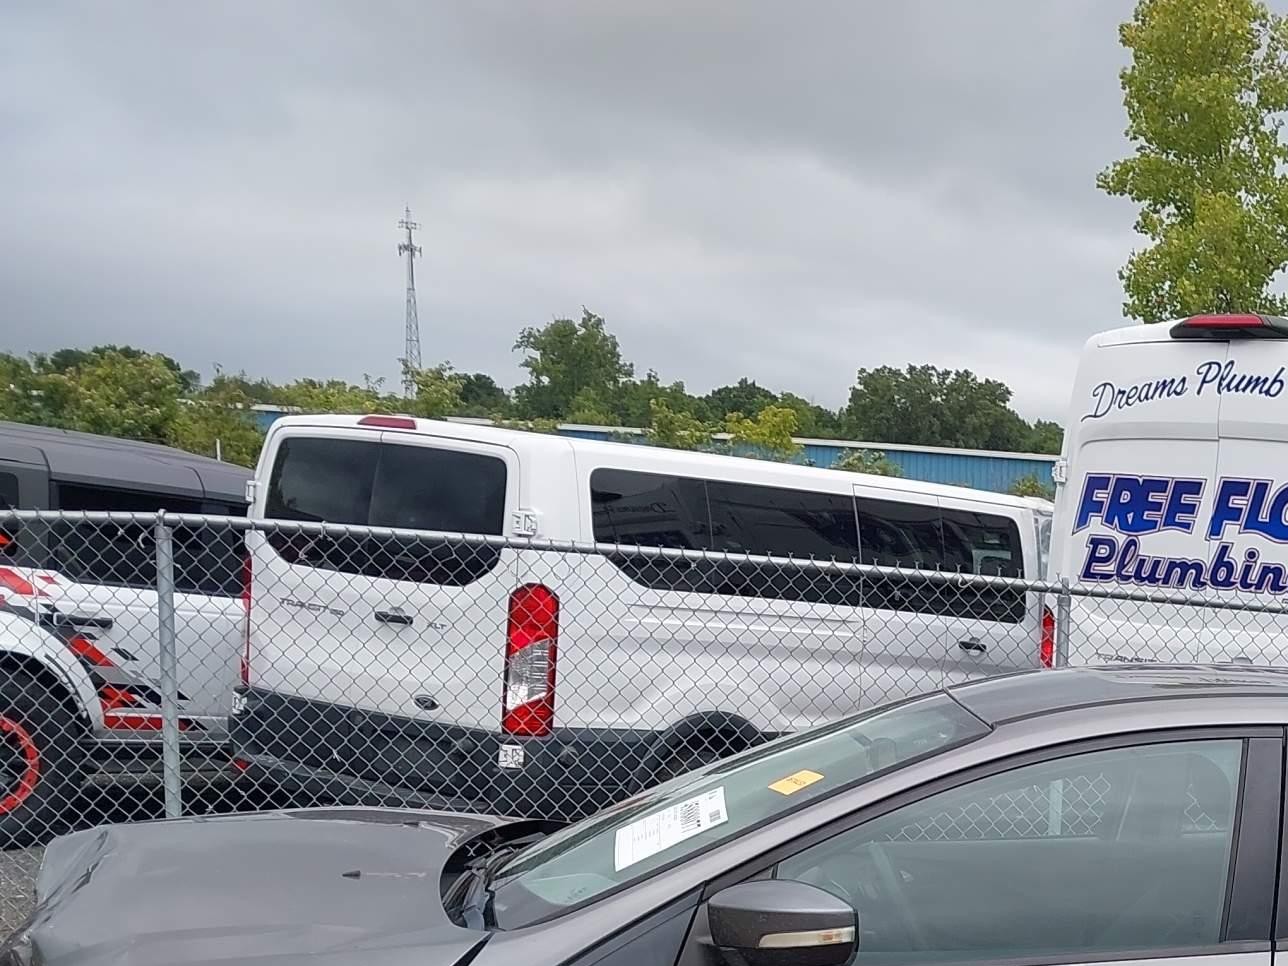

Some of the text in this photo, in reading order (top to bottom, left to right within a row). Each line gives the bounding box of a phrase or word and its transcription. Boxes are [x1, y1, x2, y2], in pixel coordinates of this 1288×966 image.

[1080, 375, 1189, 423] Dreams
[1197, 360, 1286, 398] Plumb
[1072, 472, 1207, 536] FREE
